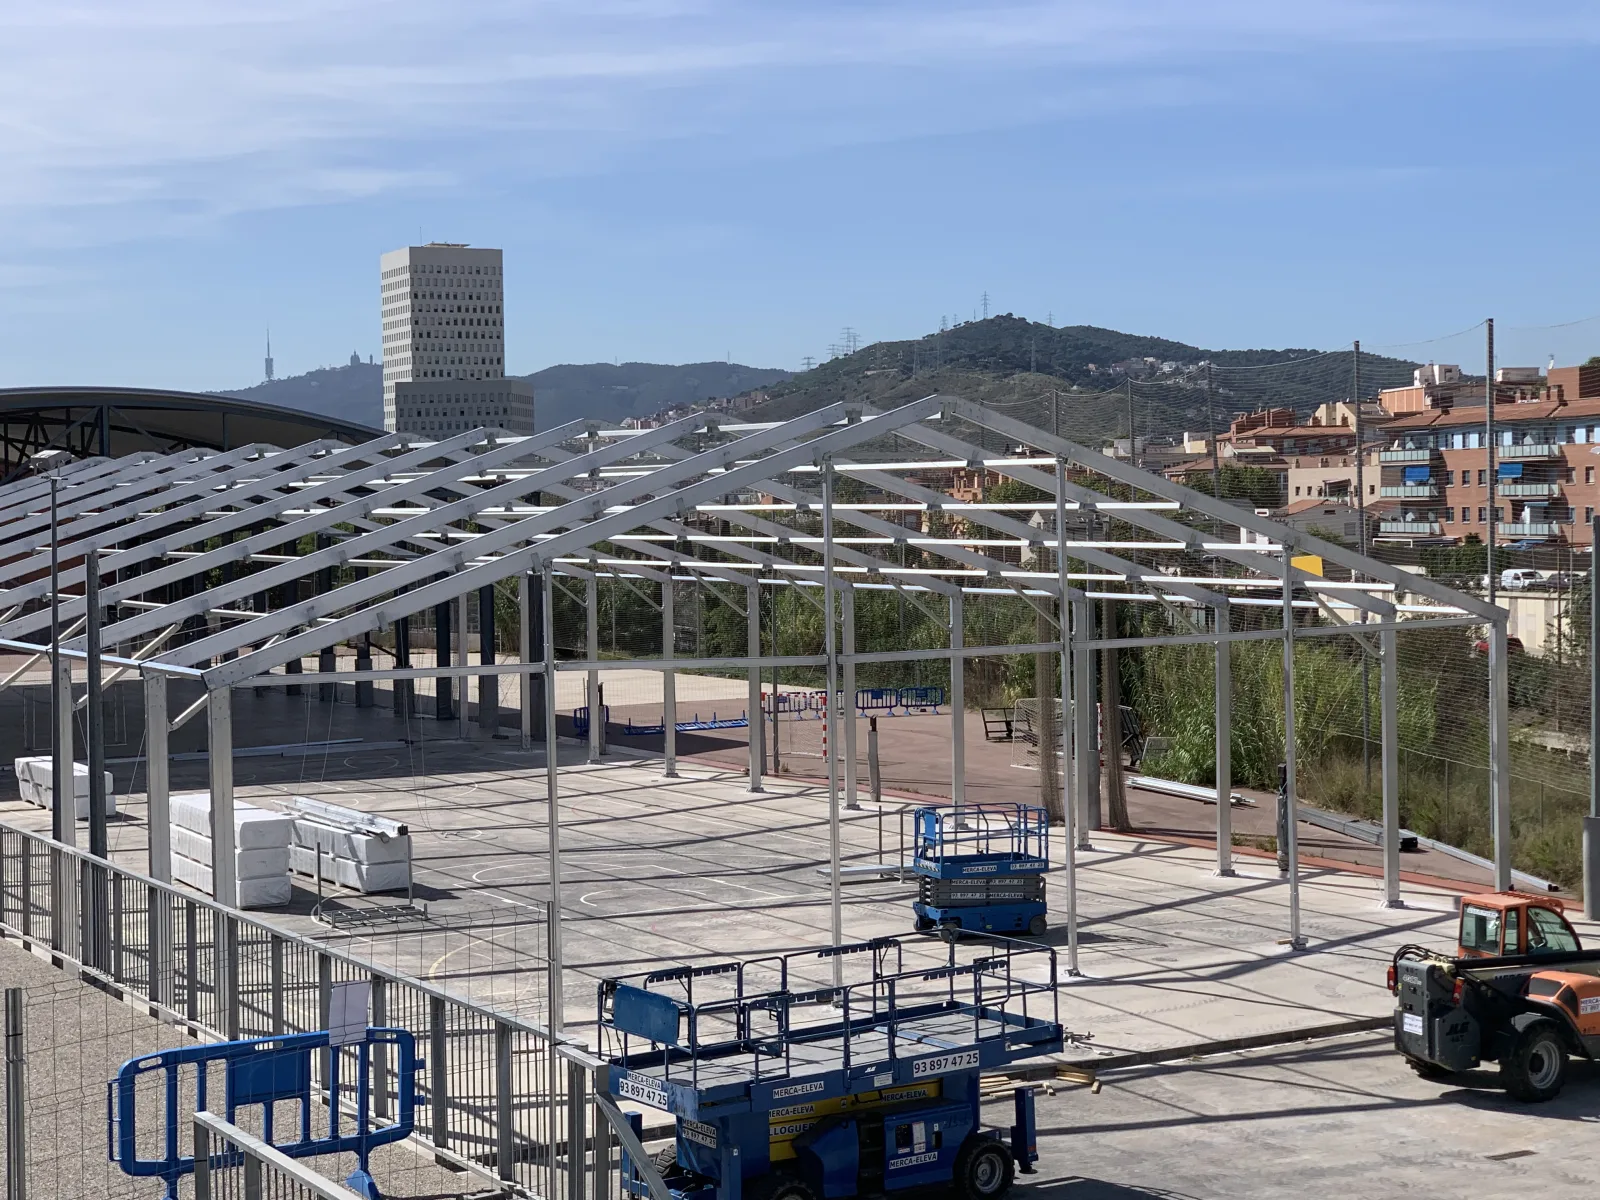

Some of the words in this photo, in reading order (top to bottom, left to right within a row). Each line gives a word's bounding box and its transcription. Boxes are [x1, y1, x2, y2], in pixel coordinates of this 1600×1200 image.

[963, 865, 997, 873] MERCA-ELEVA
[914, 1062, 927, 1074] 93
[929, 1058, 949, 1071] 897
[951, 1055, 964, 1067] 47
[966, 1052, 979, 1064] 25
[627, 1072, 661, 1090] MERCA-ELEVA
[620, 1081, 629, 1093] 93
[630, 1084, 645, 1098] 897
[646, 1090, 656, 1102] 47
[657, 1093, 667, 1106] 25
[773, 1082, 824, 1098] MERCA-ELEVA
[882, 1088, 927, 1102] MERCA-ELEVA
[682, 1119, 716, 1136] MERCA-ELEVA
[701, 1134, 708, 1143] 47
[708, 1137, 716, 1147] 25
[889, 1153, 937, 1169] MERCA-ELEVA
